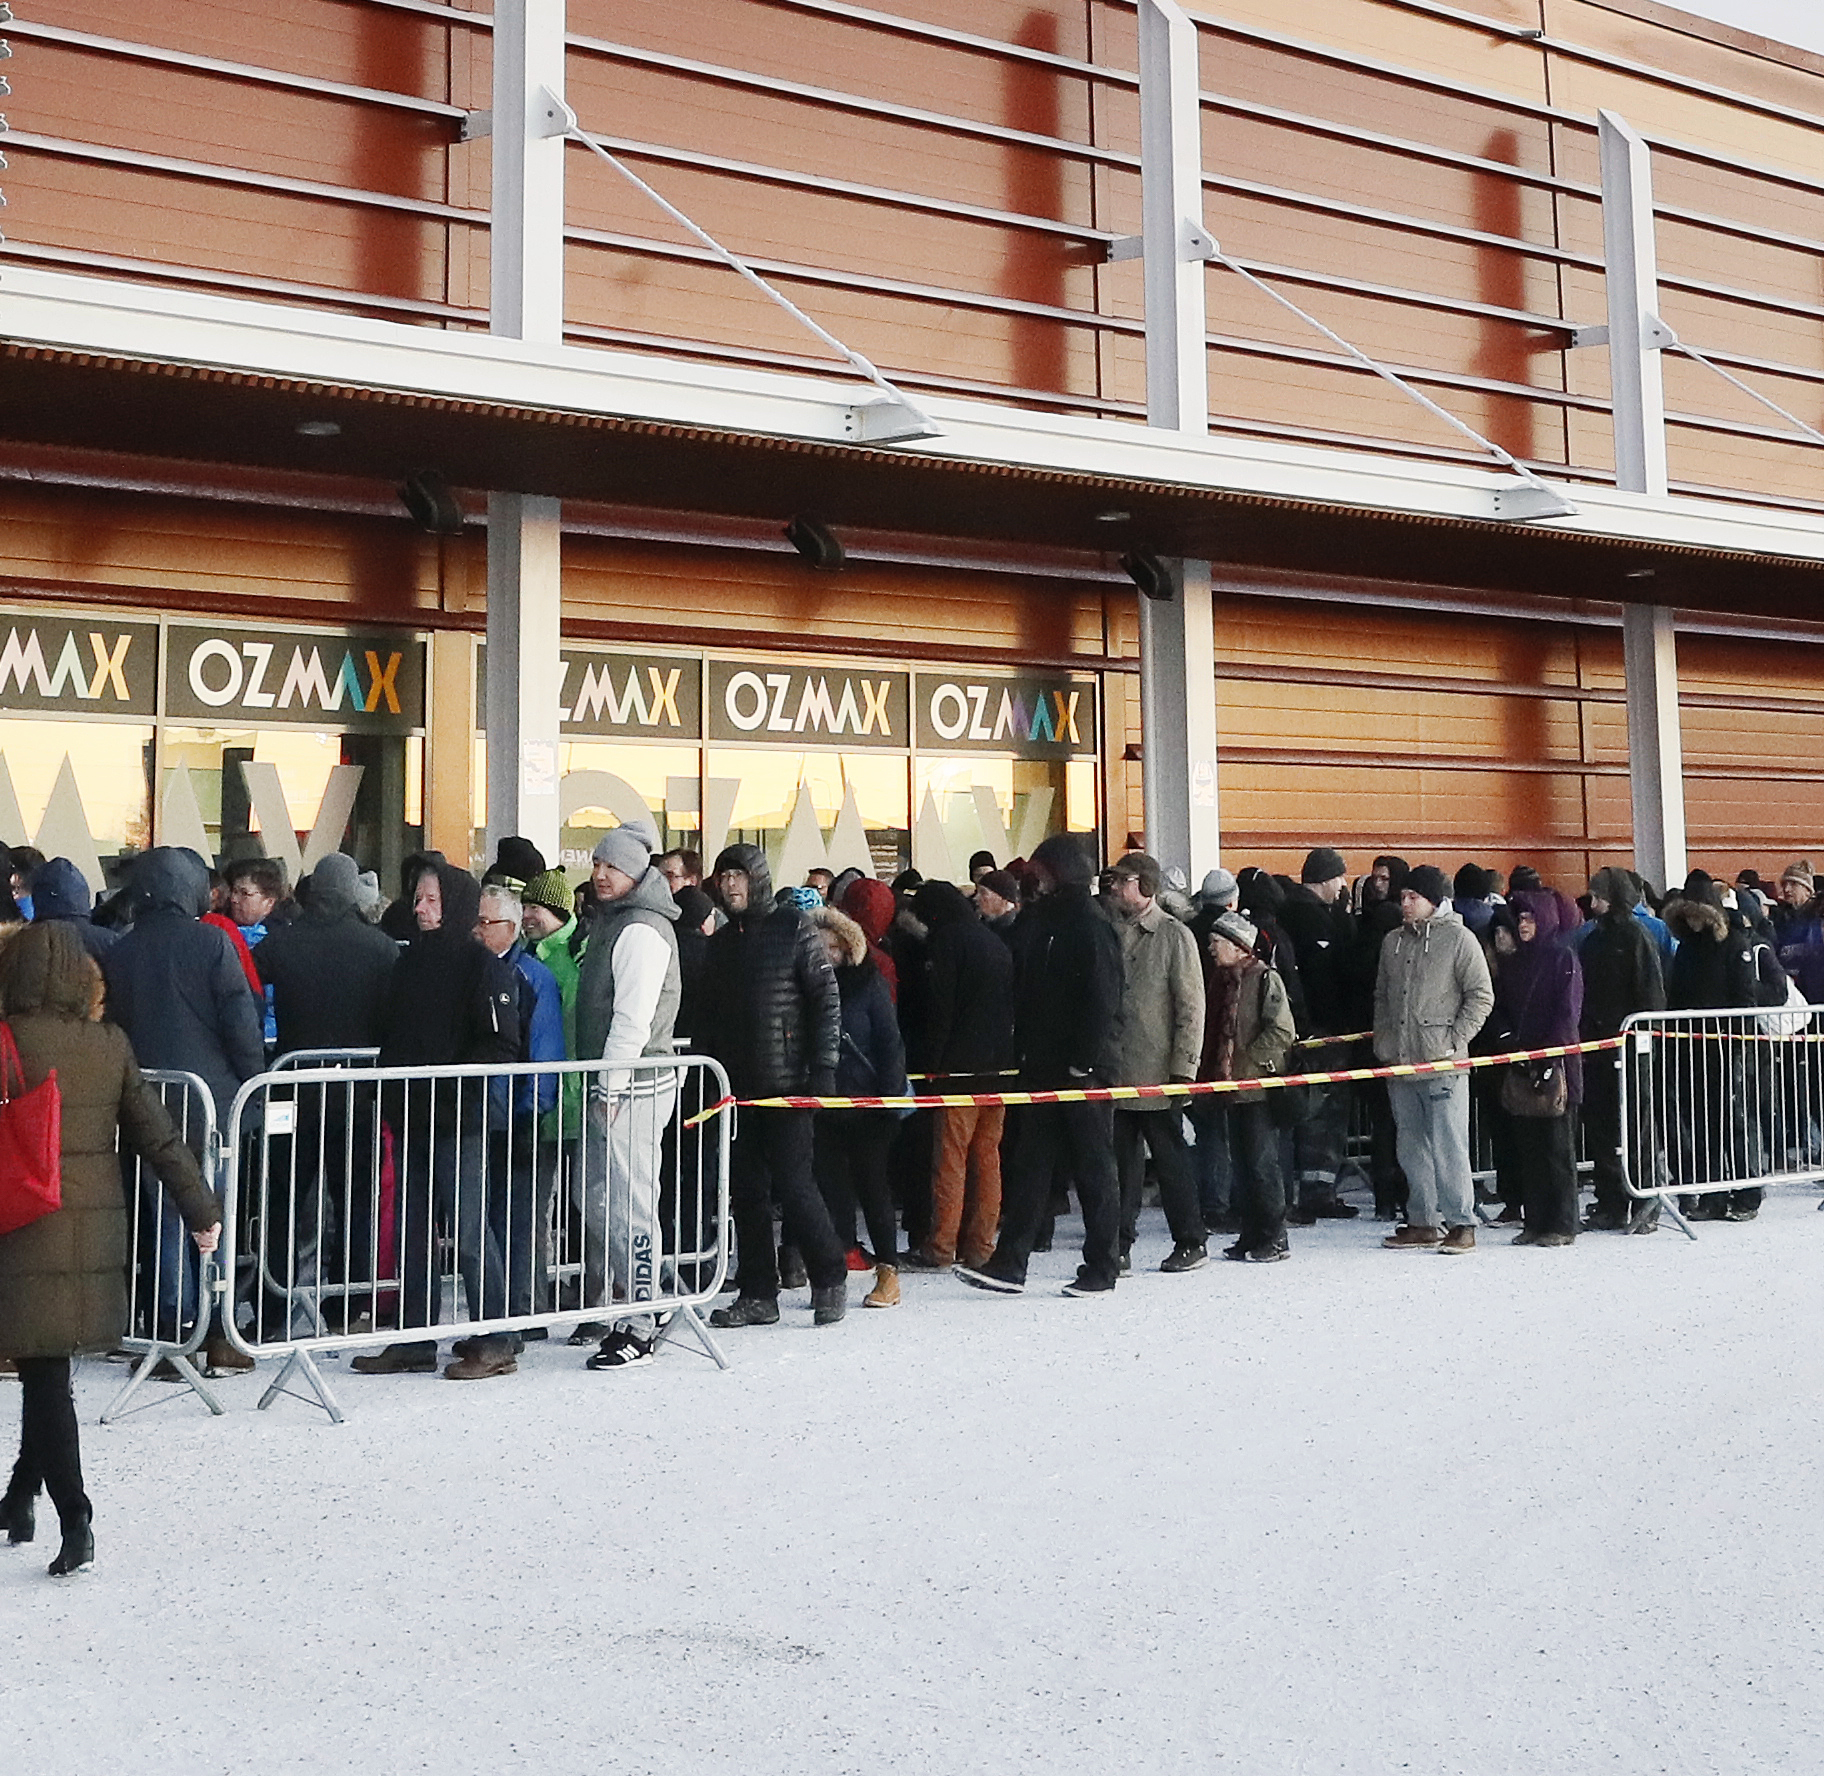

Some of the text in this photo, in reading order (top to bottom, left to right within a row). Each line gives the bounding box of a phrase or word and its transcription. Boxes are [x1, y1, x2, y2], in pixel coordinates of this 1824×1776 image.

[188, 638, 402, 714] OZMAX
[559, 661, 682, 727] MAX
[725, 670, 892, 738] OZMAX
[930, 681, 1081, 744] OZMAX
[634, 1234, 652, 1302] DIDAS
